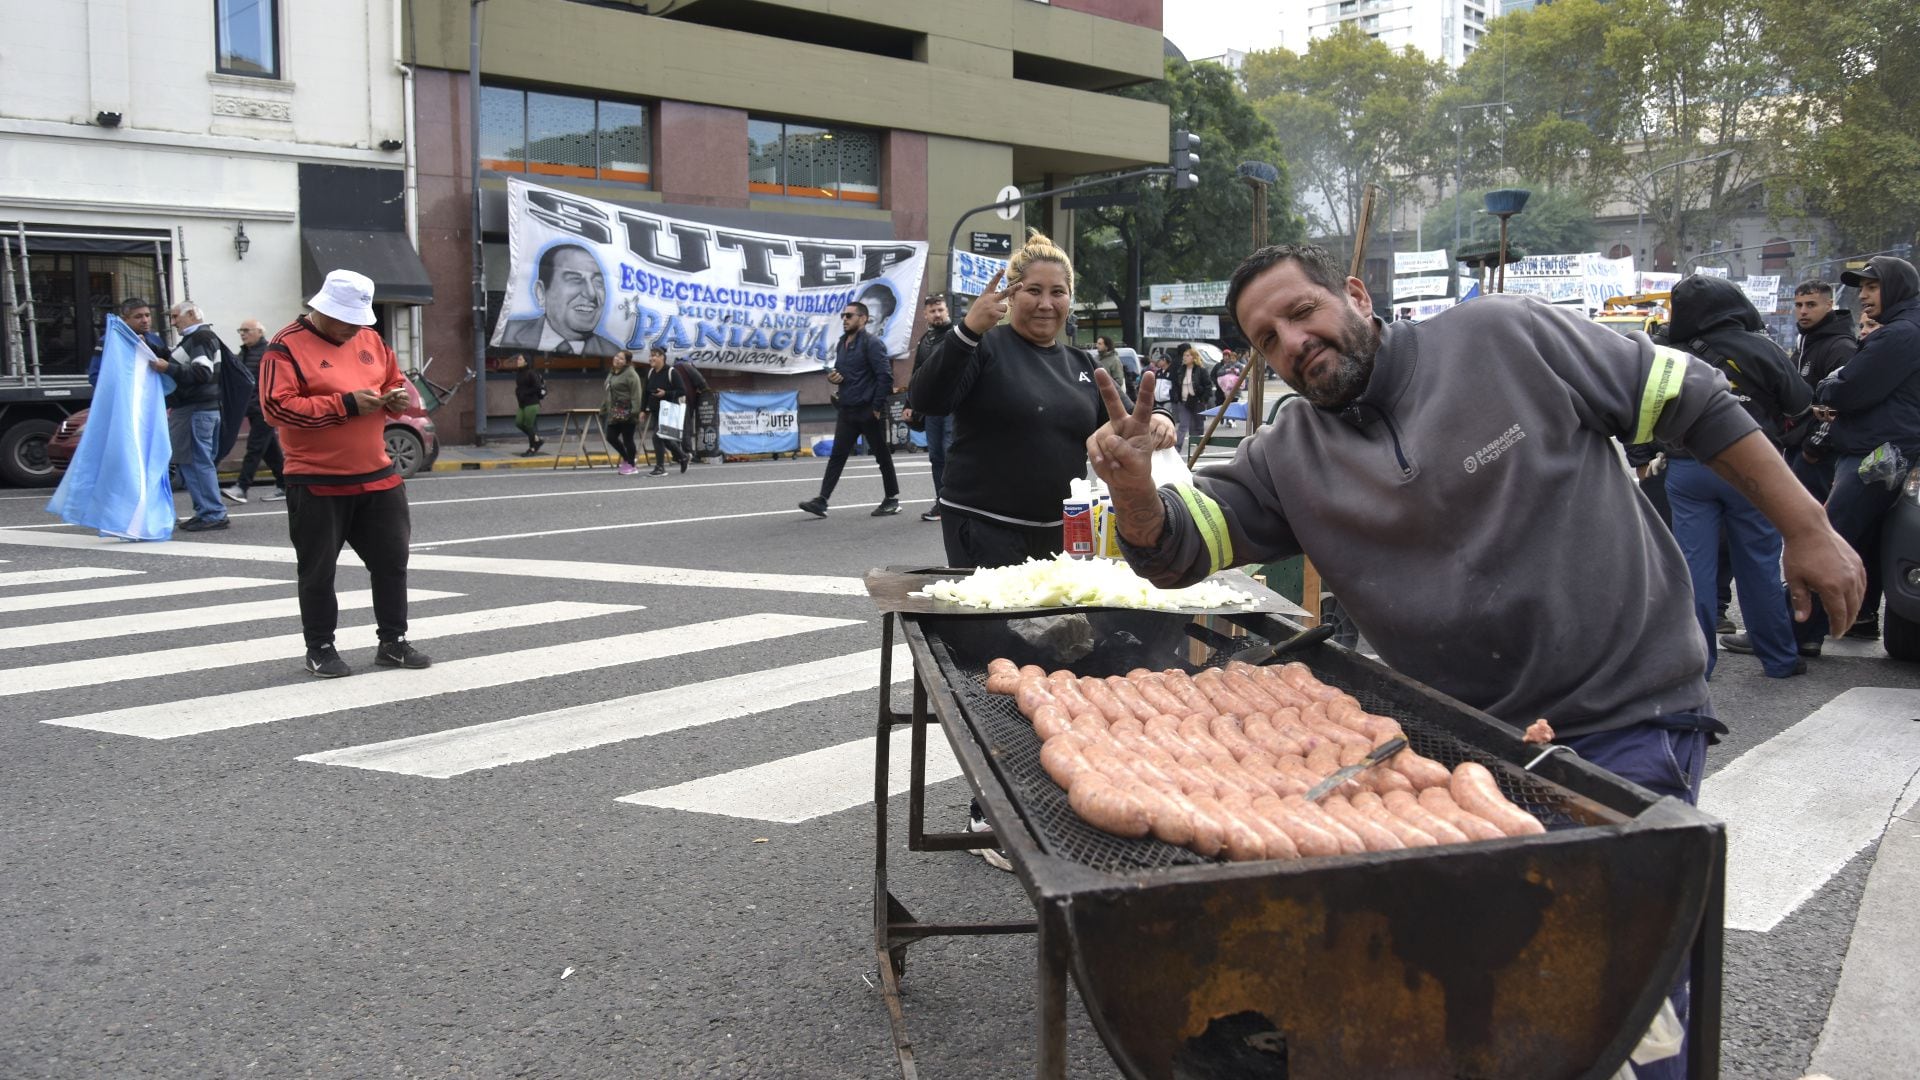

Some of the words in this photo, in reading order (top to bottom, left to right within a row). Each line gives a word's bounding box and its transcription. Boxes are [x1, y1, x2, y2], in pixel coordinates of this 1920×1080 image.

[526, 190, 916, 289] SUTEP
[619, 262, 778, 310] ESPECTACULOS
[678, 304, 754, 328] MIGUEL
[761, 313, 811, 329] ANGEL
[1180, 315, 1203, 327] CGT
[626, 305, 830, 362] PANIAGUA
[689, 350, 788, 367] CONDUCCION
[771, 414, 794, 428] UTEP
[1475, 424, 1520, 459] BARRACAS
